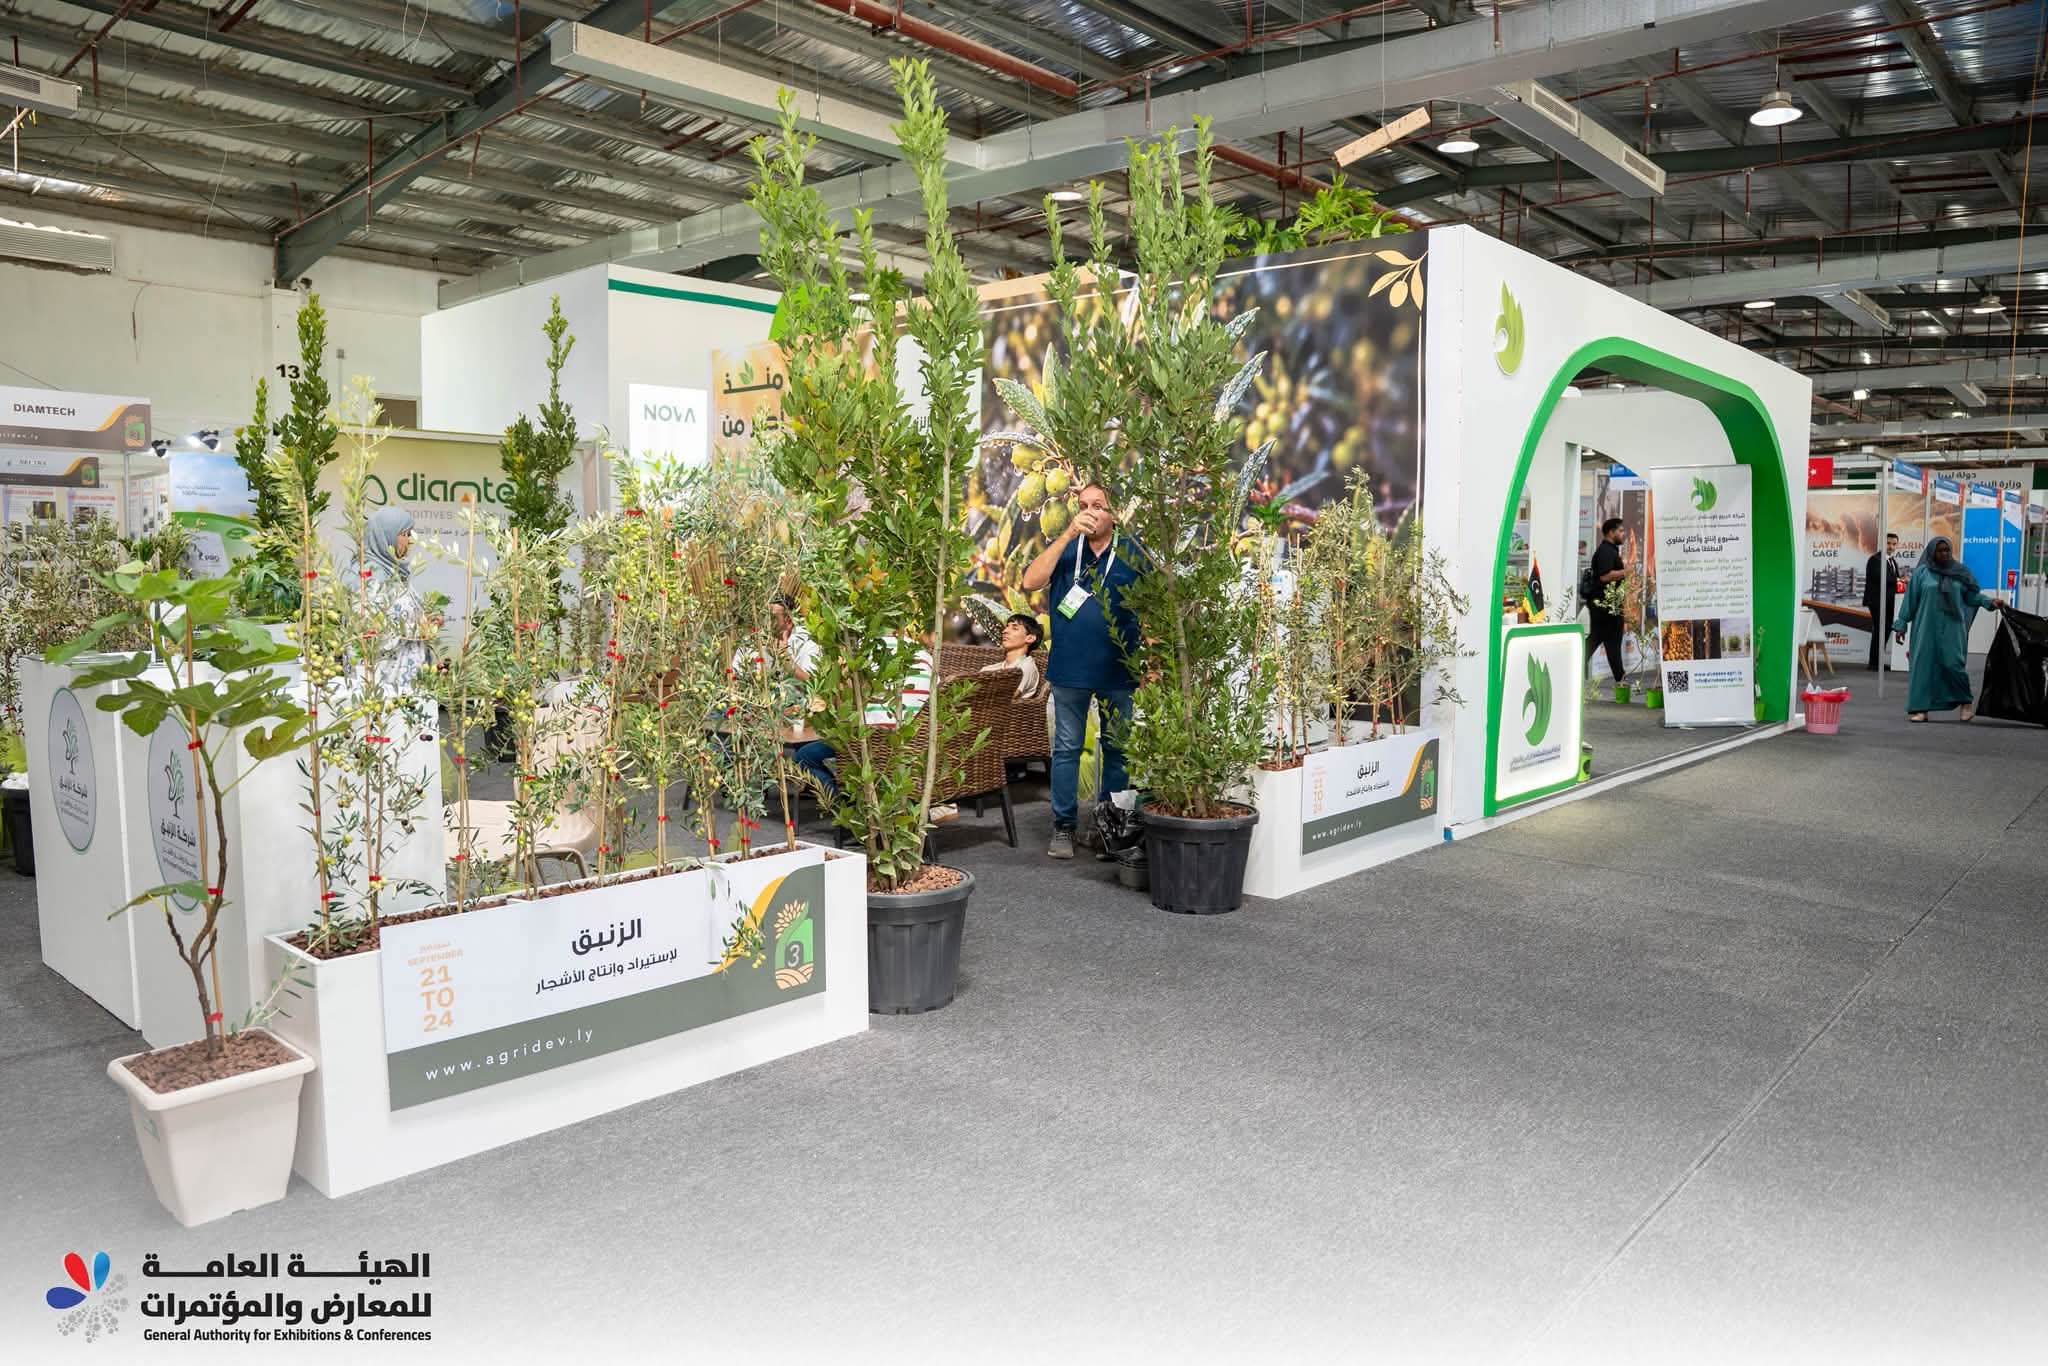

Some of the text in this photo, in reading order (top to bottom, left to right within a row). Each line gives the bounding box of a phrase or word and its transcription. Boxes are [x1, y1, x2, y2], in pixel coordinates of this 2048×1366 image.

[276, 364, 300, 379] 13
[723, 365, 784, 395] منذ
[13, 403, 76, 416] DIAMTECH
[643, 404, 696, 424] NOVA
[722, 414, 745, 438] من
[1812, 550, 1839, 558] CAGE
[1894, 551, 1917, 559] AGE
[571, 917, 643, 956] الزنبق
[787, 944, 801, 967] 3
[420, 964, 452, 987] 21
[535, 947, 678, 995] لإستيراد وإنتاج الأشجار
[421, 987, 454, 1011] TO
[423, 1011, 454, 1033] 24
[424, 1026, 595, 1081] www.agridev.ly
